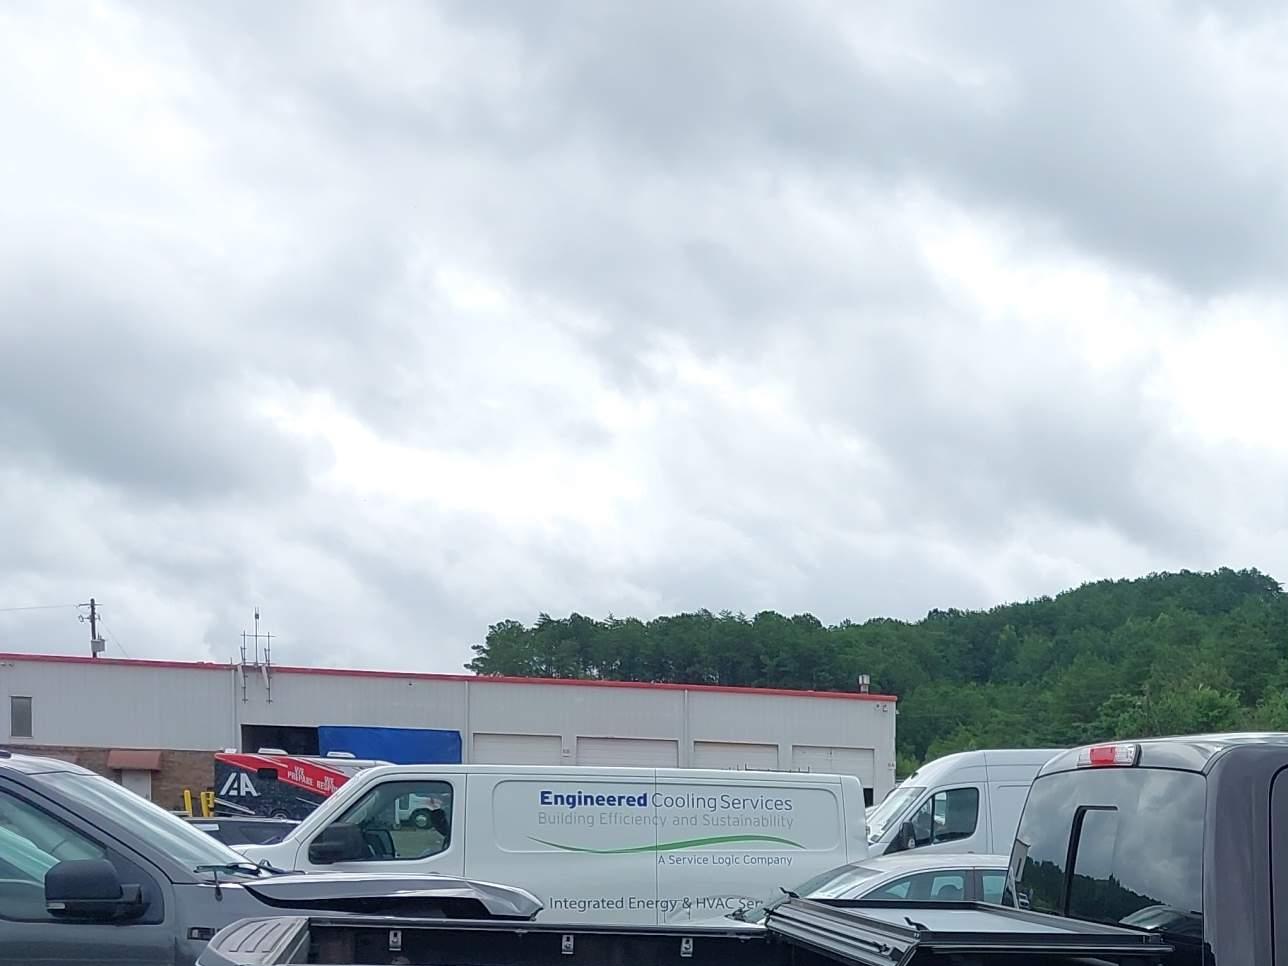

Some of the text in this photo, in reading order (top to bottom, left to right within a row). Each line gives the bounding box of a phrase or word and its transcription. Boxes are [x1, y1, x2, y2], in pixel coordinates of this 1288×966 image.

[540, 790, 793, 812] Engineered Cooling Services
[538, 811, 794, 829] Building Efficiency and Sustainability
[658, 855, 793, 867] A Service Logic Company
[549, 897, 763, 912] Integrated Energy & HVAC Ser
